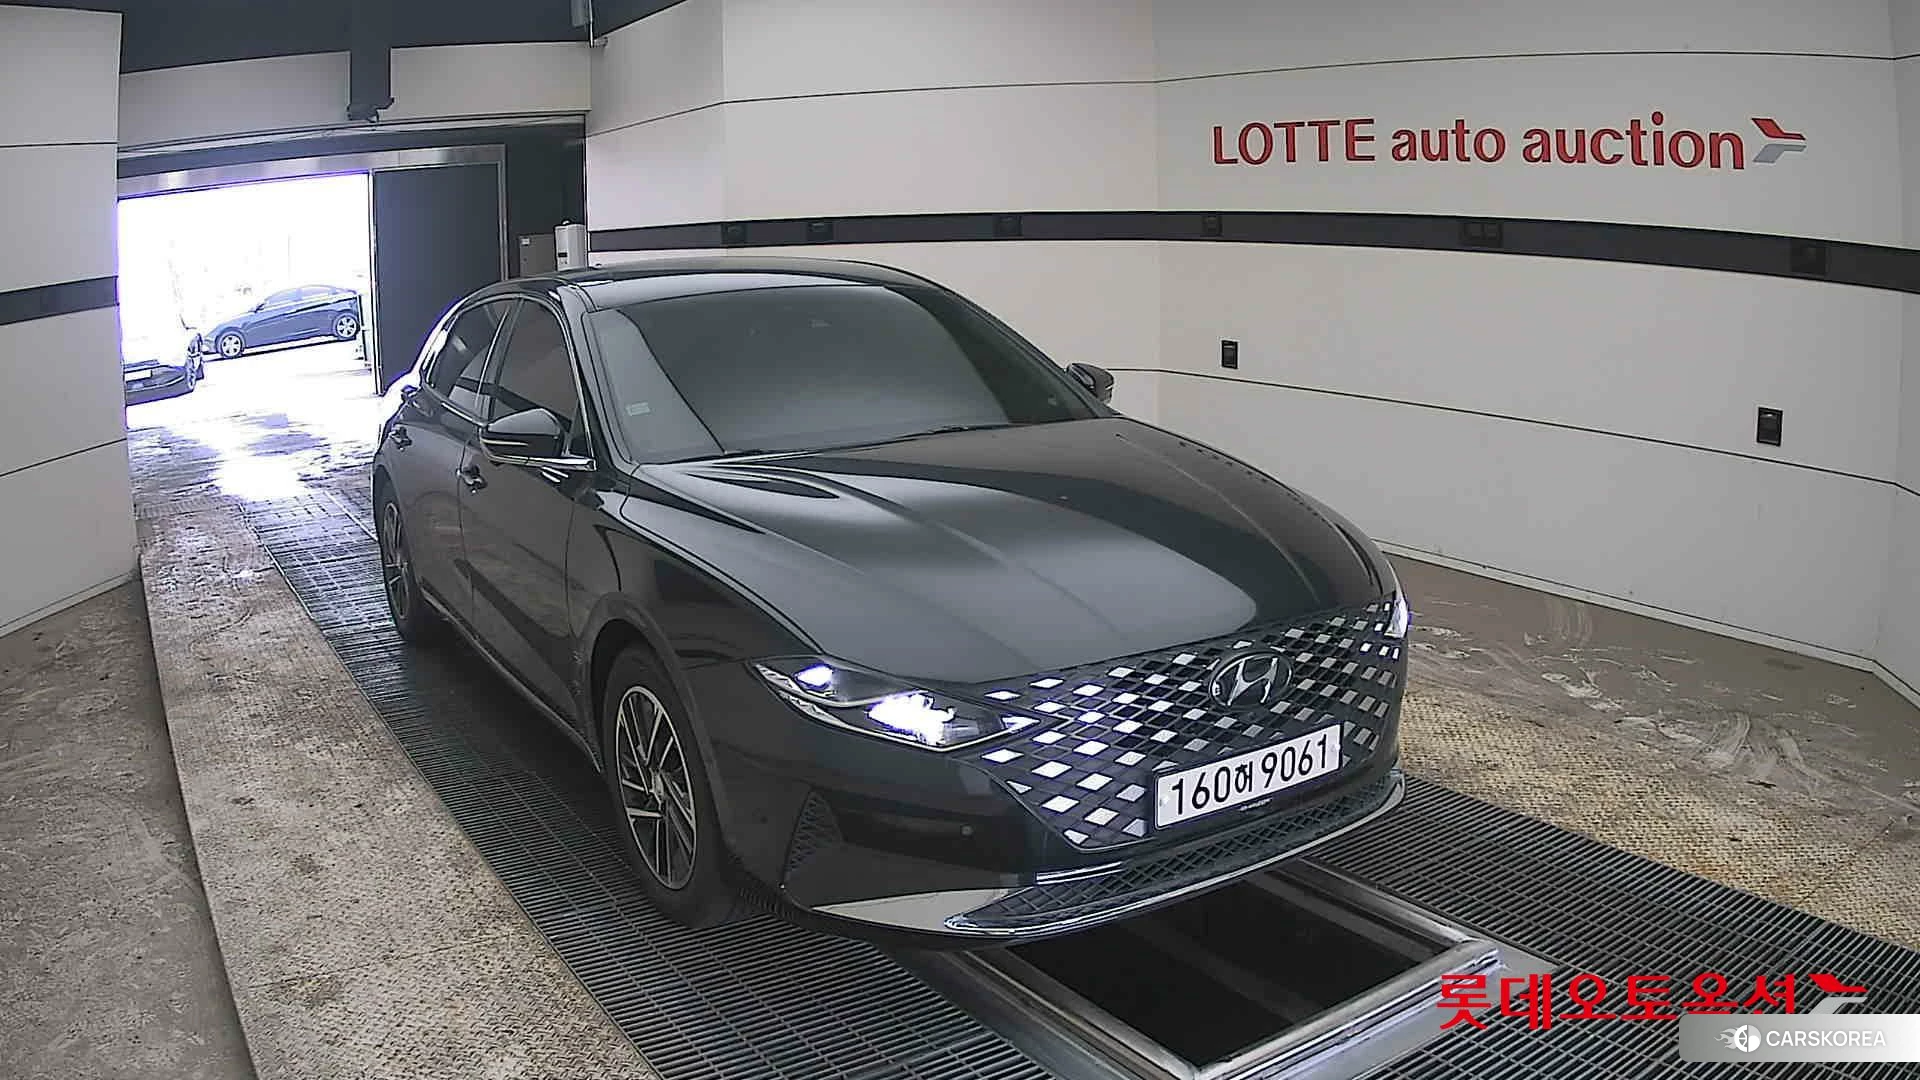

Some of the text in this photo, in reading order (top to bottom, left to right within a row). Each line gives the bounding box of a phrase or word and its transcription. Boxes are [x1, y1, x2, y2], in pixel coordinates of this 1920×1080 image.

[1212, 111, 1746, 170] LOTTE auto auction
[1171, 733, 1328, 815] 160허 9061
